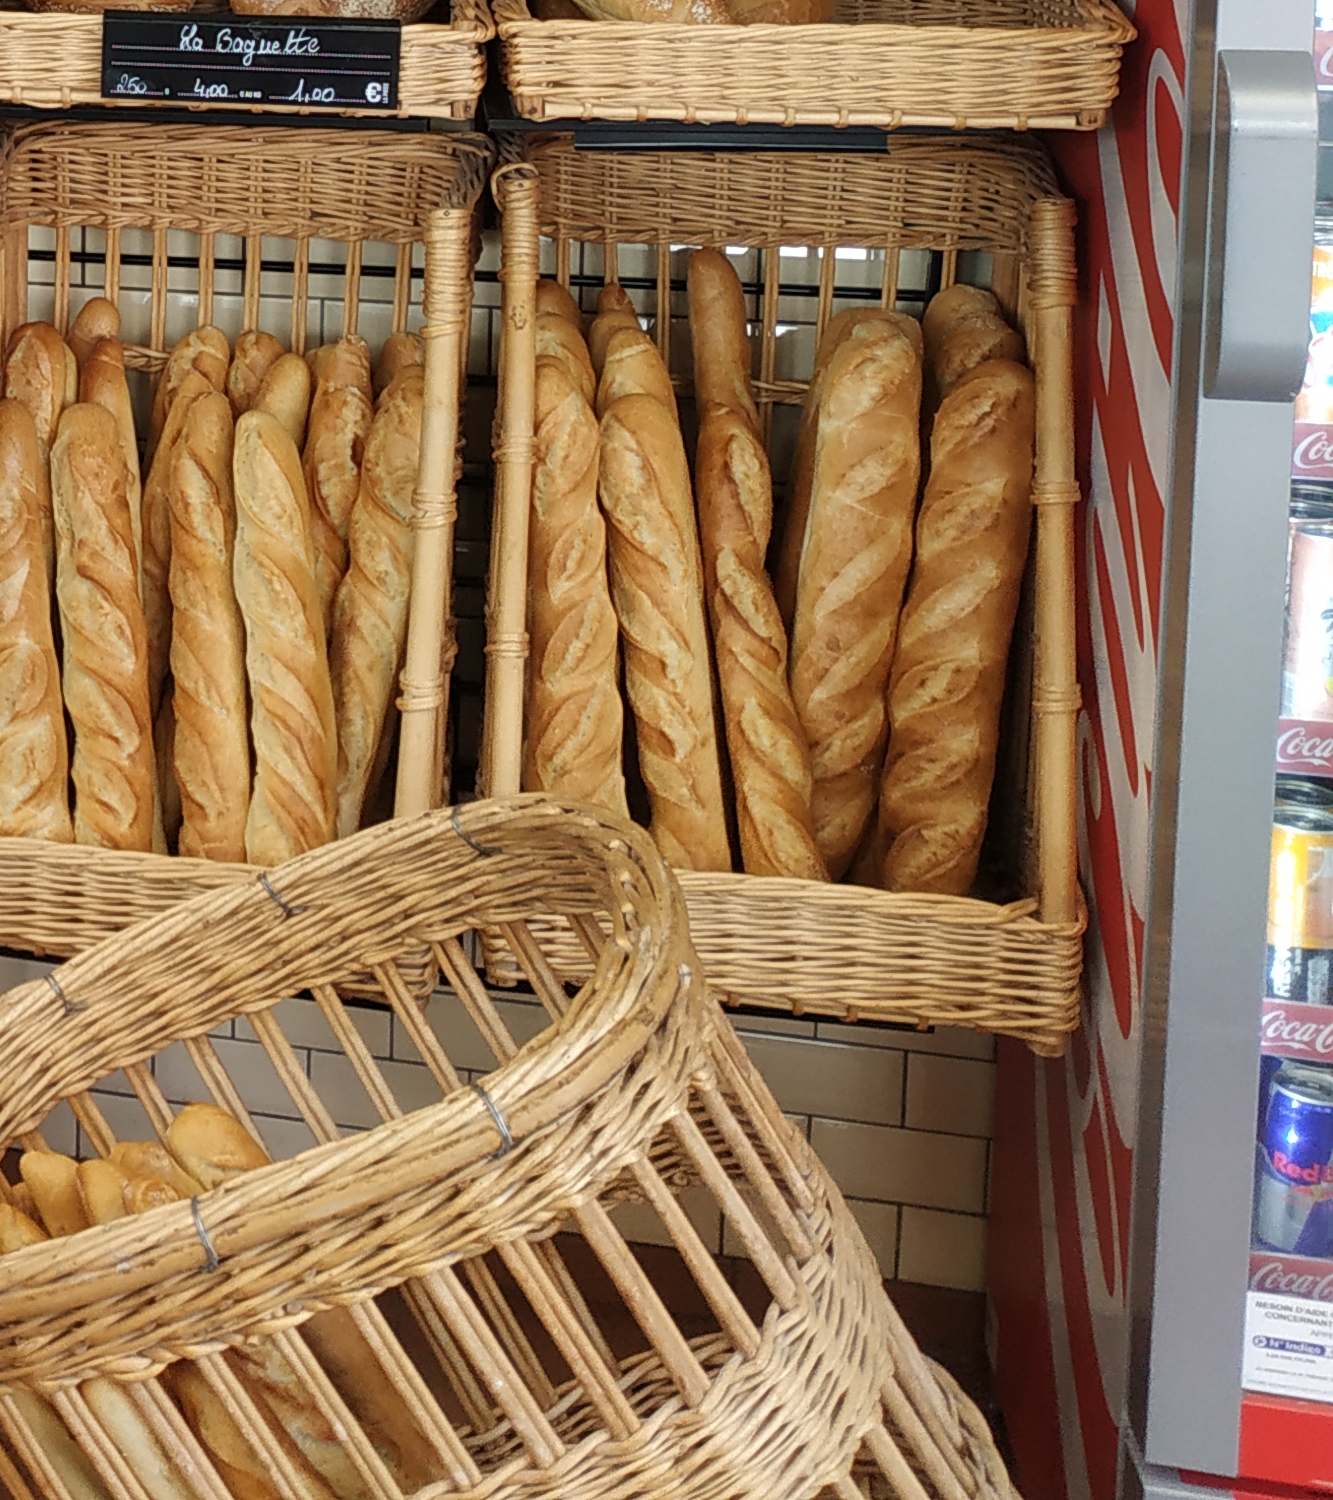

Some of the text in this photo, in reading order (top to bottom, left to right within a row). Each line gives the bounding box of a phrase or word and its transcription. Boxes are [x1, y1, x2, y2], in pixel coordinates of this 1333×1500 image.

[179, 24, 321, 66] La Baguette
[117, 74, 148, 93] 250
[289, 78, 335, 103] 1,00
[365, 82, 382, 103] €
[1273, 1150, 1320, 1183] Red
